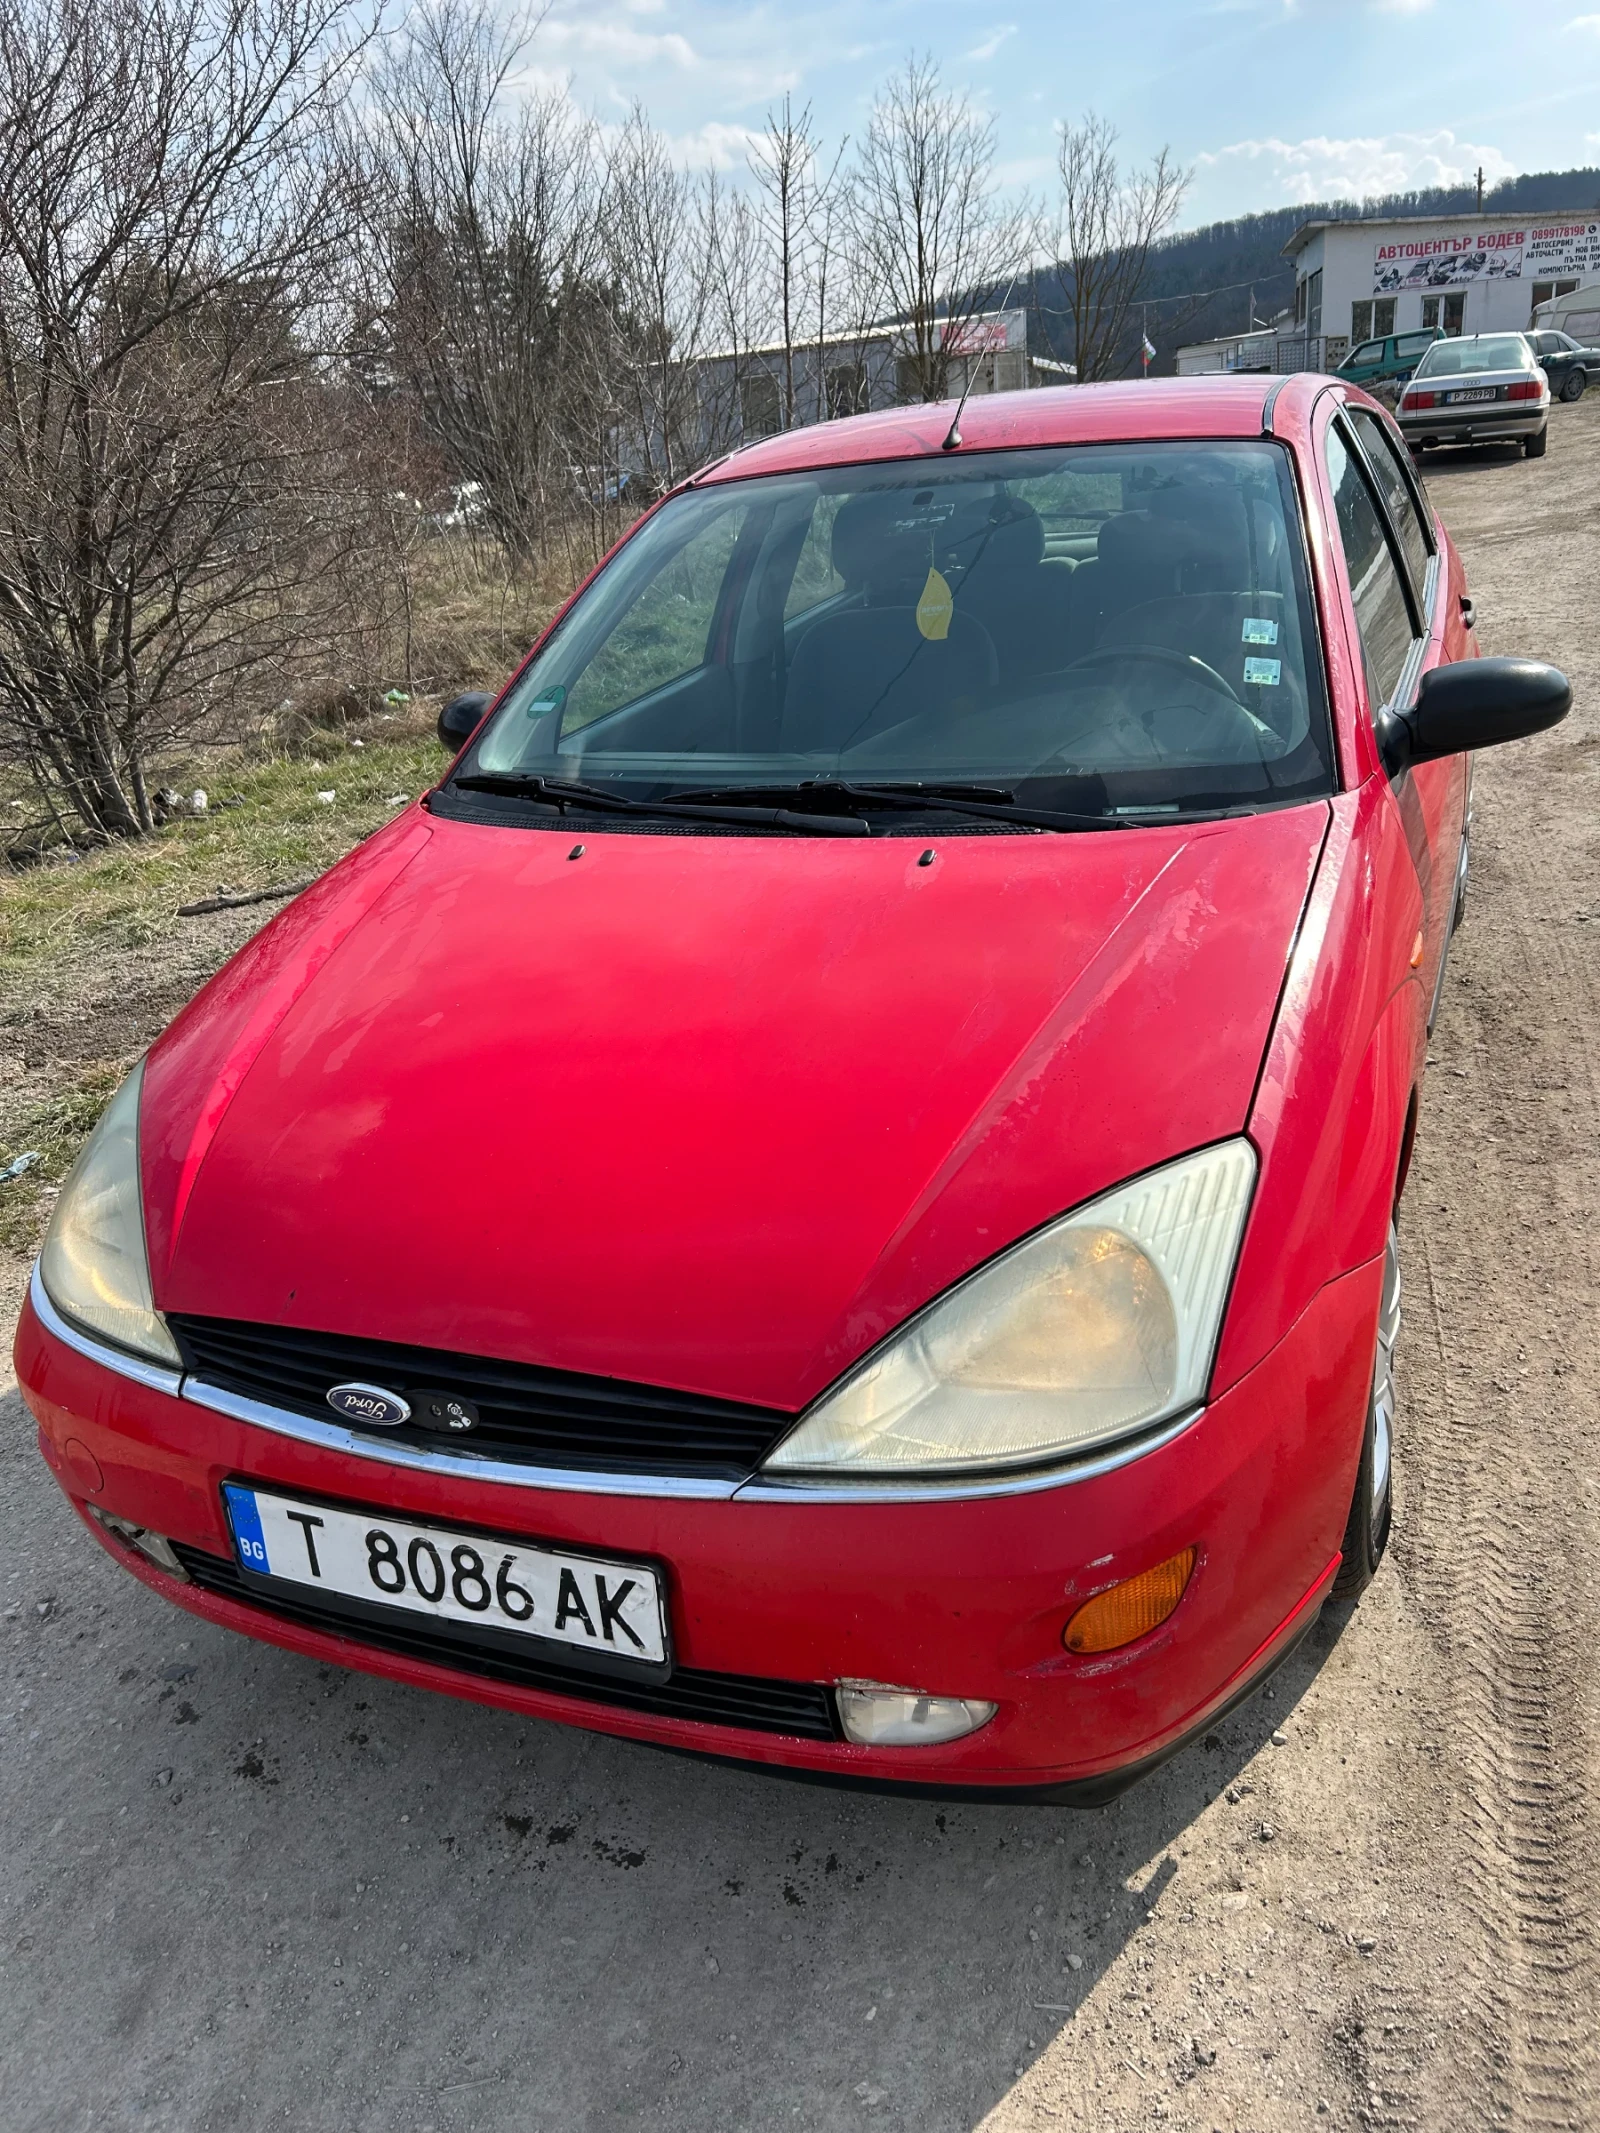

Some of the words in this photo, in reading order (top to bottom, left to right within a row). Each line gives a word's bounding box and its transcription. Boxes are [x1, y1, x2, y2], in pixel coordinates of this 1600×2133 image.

[1532, 225, 1585, 240] 0899178198
[1378, 237, 1472, 260] АВТОЦЕНТЪР
[1477, 231, 1525, 249] БОДЕВ
[1526, 248, 1564, 259] АВТОЧАСТИ
[1575, 245, 1589, 254] НОВ
[1531, 239, 1574, 250] АВТОСЕРВИЗ
[1564, 254, 1587, 263] ПЪТНА
[1538, 263, 1585, 275] КОМПЮТЪРНА
[1463, 390, 1483, 400] 2289
[544, 686, 559, 702] 4
[344, 1394, 388, 1420] Ford
[239, 1536, 265, 1561] BG
[286, 1510, 324, 1578] T
[364, 1528, 536, 1622] 8086
[554, 1566, 646, 1651] AK
